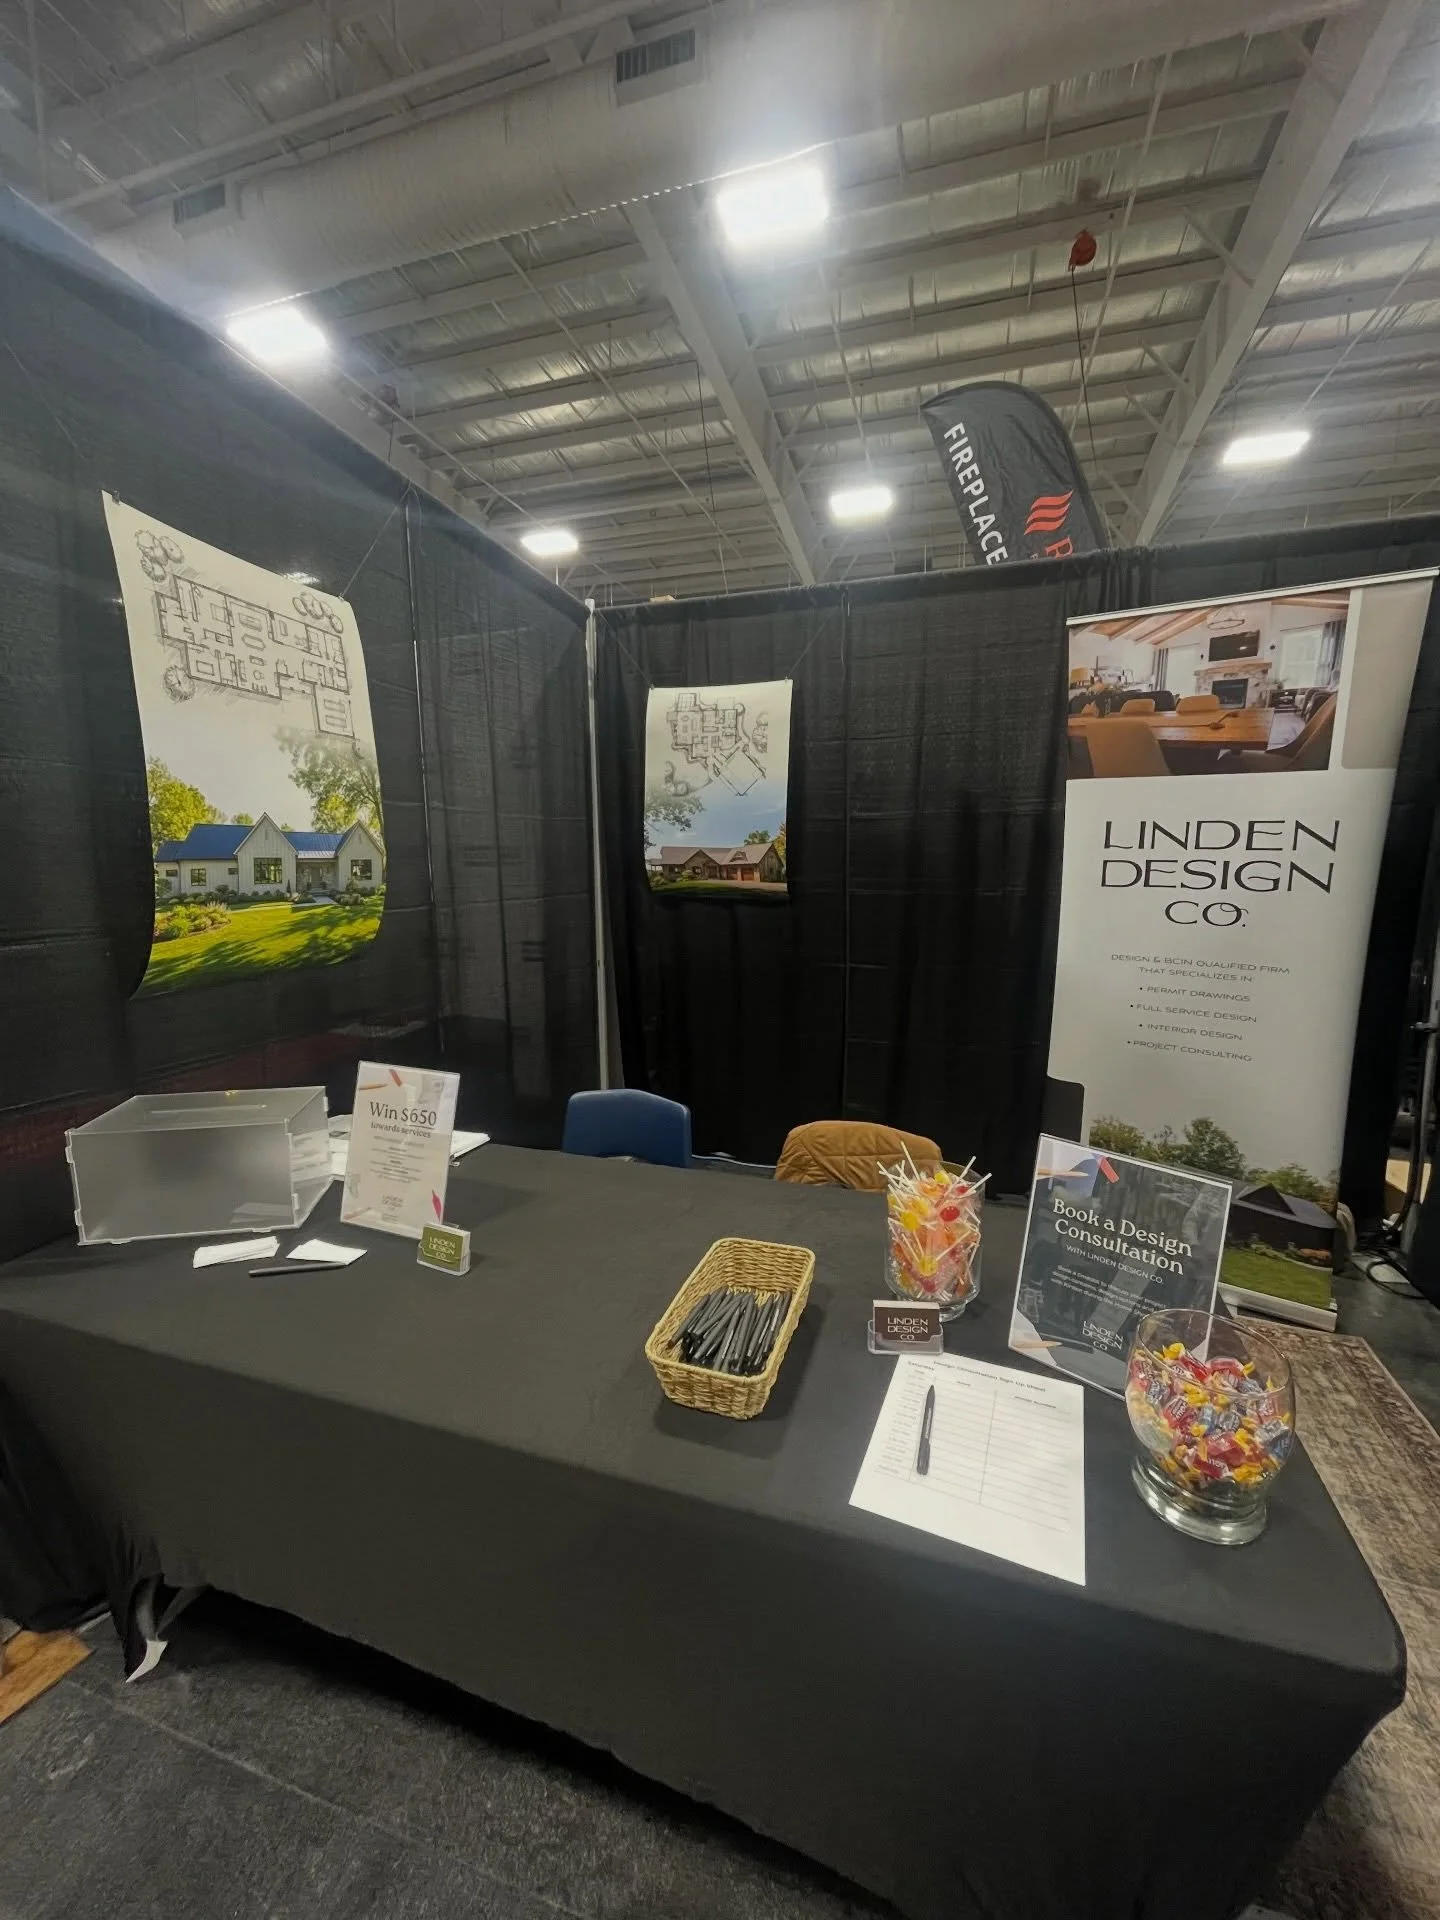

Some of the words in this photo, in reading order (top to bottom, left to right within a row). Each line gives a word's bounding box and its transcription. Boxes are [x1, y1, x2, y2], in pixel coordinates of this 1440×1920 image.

[943, 422, 1009, 566] FIREPLACE
[1103, 820, 1340, 852] LINDEN
[1100, 859, 1335, 894] DESIGN
[1164, 900, 1249, 928] CO.
[1111, 954, 1150, 963] DESIGN
[1164, 957, 1193, 966] BCIN
[1196, 960, 1257, 971] QUALIFIED
[1259, 965, 1290, 974] FIRM
[1139, 966, 1165, 974] THAT
[1168, 969, 1237, 981] SPECIALIZES
[1147, 986, 1187, 995] PERMIT
[1189, 990, 1251, 1002] DRAWINGS
[1136, 1003, 1162, 1012] FULL
[1165, 1006, 1211, 1018] SERVICE
[1213, 1011, 1257, 1023] DESIGN
[1147, 1023, 1197, 1035] INTERIOR
[1199, 1029, 1243, 1041] DESIGN
[1133, 1039, 1178, 1051] PROJECT
[1180, 1046, 1252, 1062] CONSULTING
[370, 1101, 398, 1120] Win
[400, 1107, 437, 1126] $650
[370, 1121, 400, 1133] towards
[400, 1127, 432, 1139] services
[1053, 1198, 1100, 1227] Book
[1103, 1219, 1116, 1232] a
[1119, 1219, 1193, 1258] Design
[430, 1236, 456, 1249] LINDEN
[1054, 1218, 1184, 1276] Consultation
[1066, 1245, 1086, 1257] WITH
[1087, 1252, 1116, 1268] LINDEN
[1118, 1263, 1149, 1279] DESIGN
[887, 1317, 928, 1326] LINDEN
[887, 1325, 928, 1334] DESIGN
[1083, 1320, 1124, 1342] LINDEN
[1082, 1328, 1122, 1350] DESIGN
